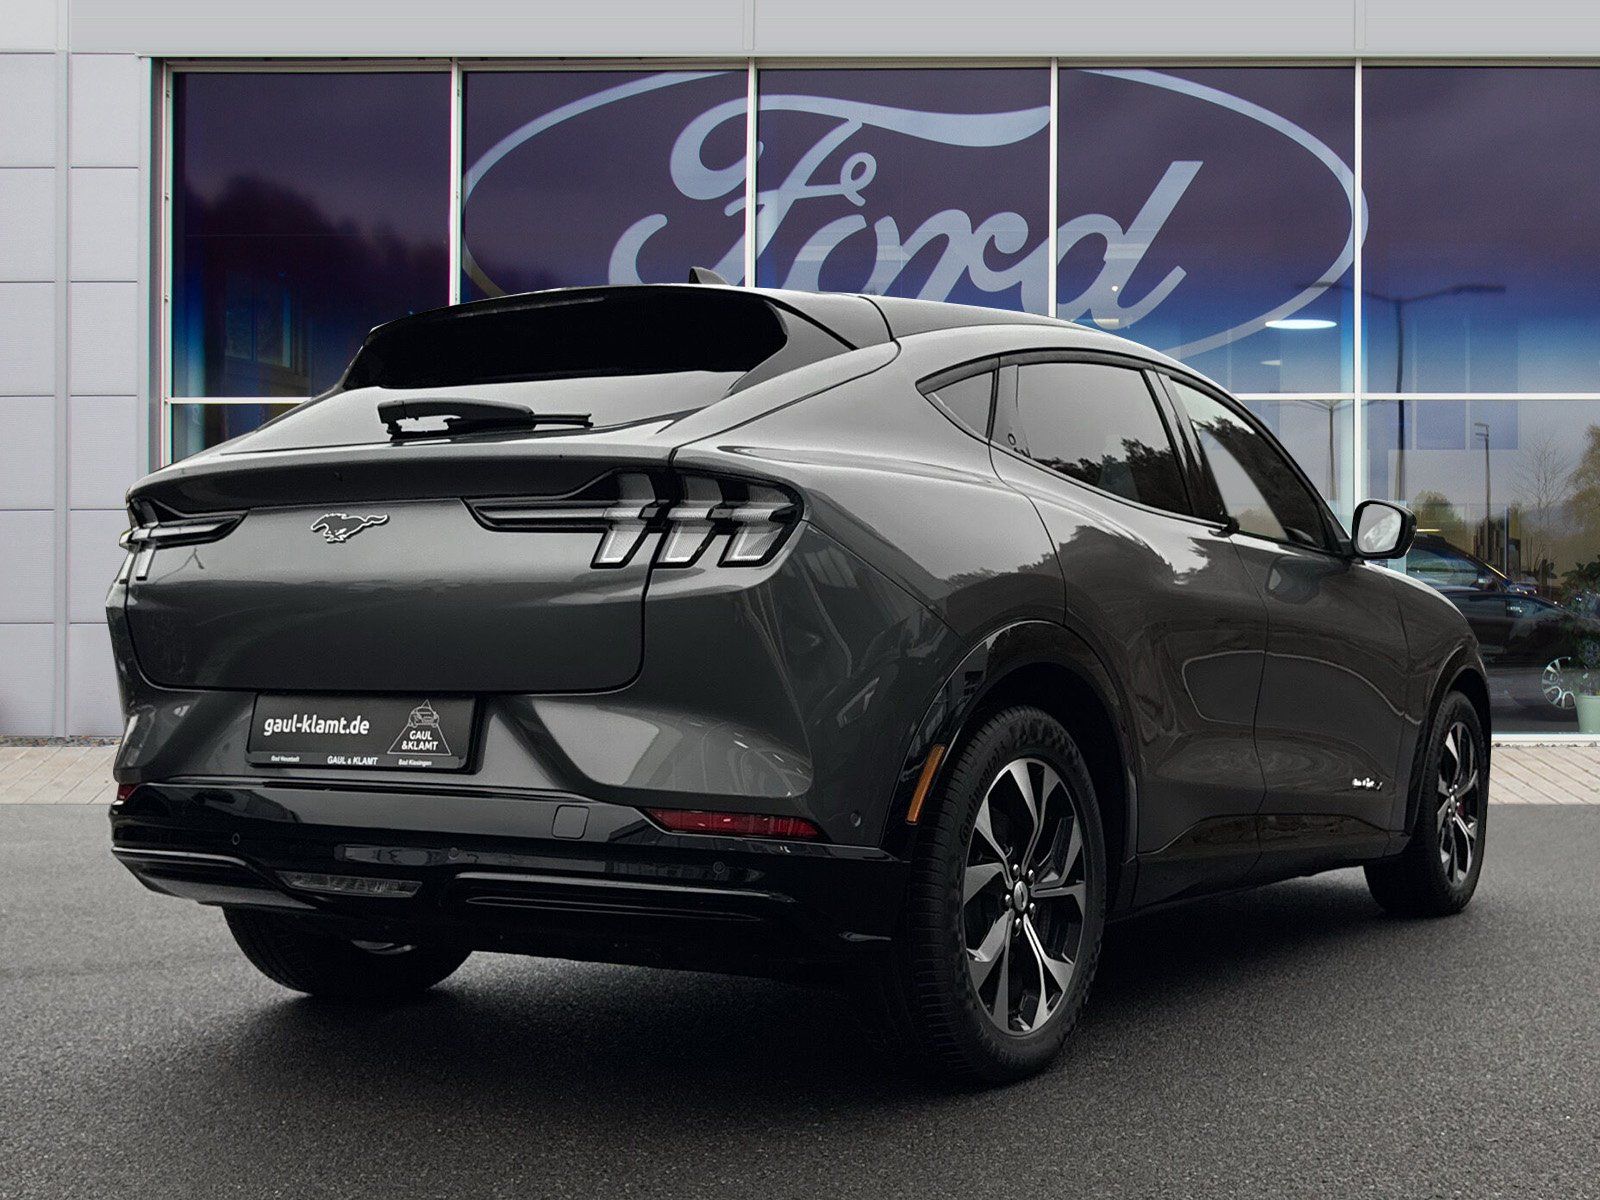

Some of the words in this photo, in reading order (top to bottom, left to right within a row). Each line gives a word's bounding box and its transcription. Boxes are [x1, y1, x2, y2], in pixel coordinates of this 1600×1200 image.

[608, 95, 1203, 330] Ford
[263, 714, 370, 736] gaul-klamt.de
[409, 730, 433, 740] GAUL
[401, 741, 438, 751] &KLAMT
[327, 755, 346, 765] GAUL
[353, 757, 378, 766] KLAMT
